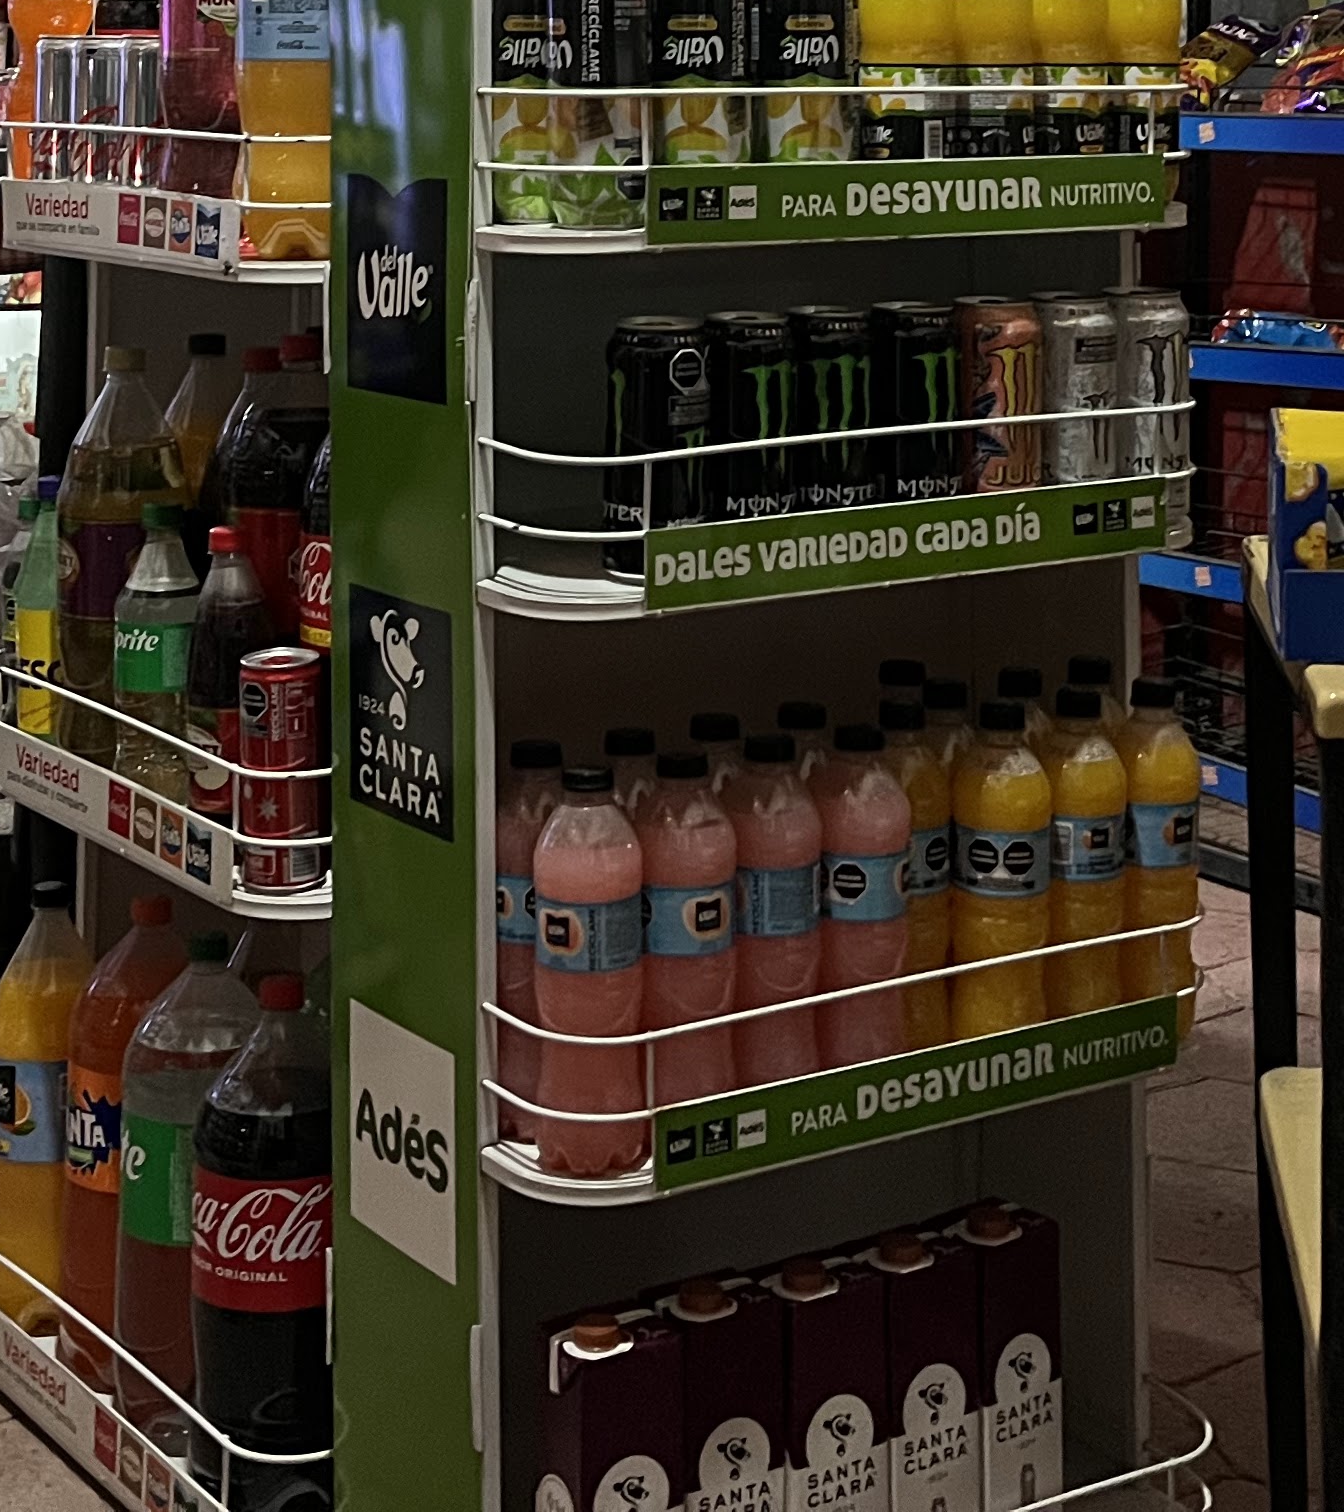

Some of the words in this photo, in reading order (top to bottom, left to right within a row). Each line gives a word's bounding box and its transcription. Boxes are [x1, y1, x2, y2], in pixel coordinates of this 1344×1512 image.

[26, 192, 90, 220] Variedad
[781, 193, 837, 218] PARA
[1050, 181, 1155, 208] NUTRITIVO.
[299, 542, 331, 606] Col
[117, 628, 159, 652] prite
[358, 693, 385, 716] 1924
[16, 744, 80, 793] Variedad
[359, 726, 441, 786] SANTA
[359, 763, 442, 824] CLARA
[68, 1108, 106, 1148] NTA
[790, 1104, 848, 1136] PARA
[193, 1183, 332, 1262] ca-Cola
[215, 1266, 288, 1283] ORIGINAL
[4, 1331, 67, 1408] Variedad
[996, 1391, 1054, 1424] SANTA
[904, 1424, 968, 1457] SANTA
[996, 1412, 1054, 1443] CLARA
[808, 1455, 876, 1489] SANTA
[904, 1444, 968, 1476] CLARA
[807, 1476, 876, 1508] CLARA
